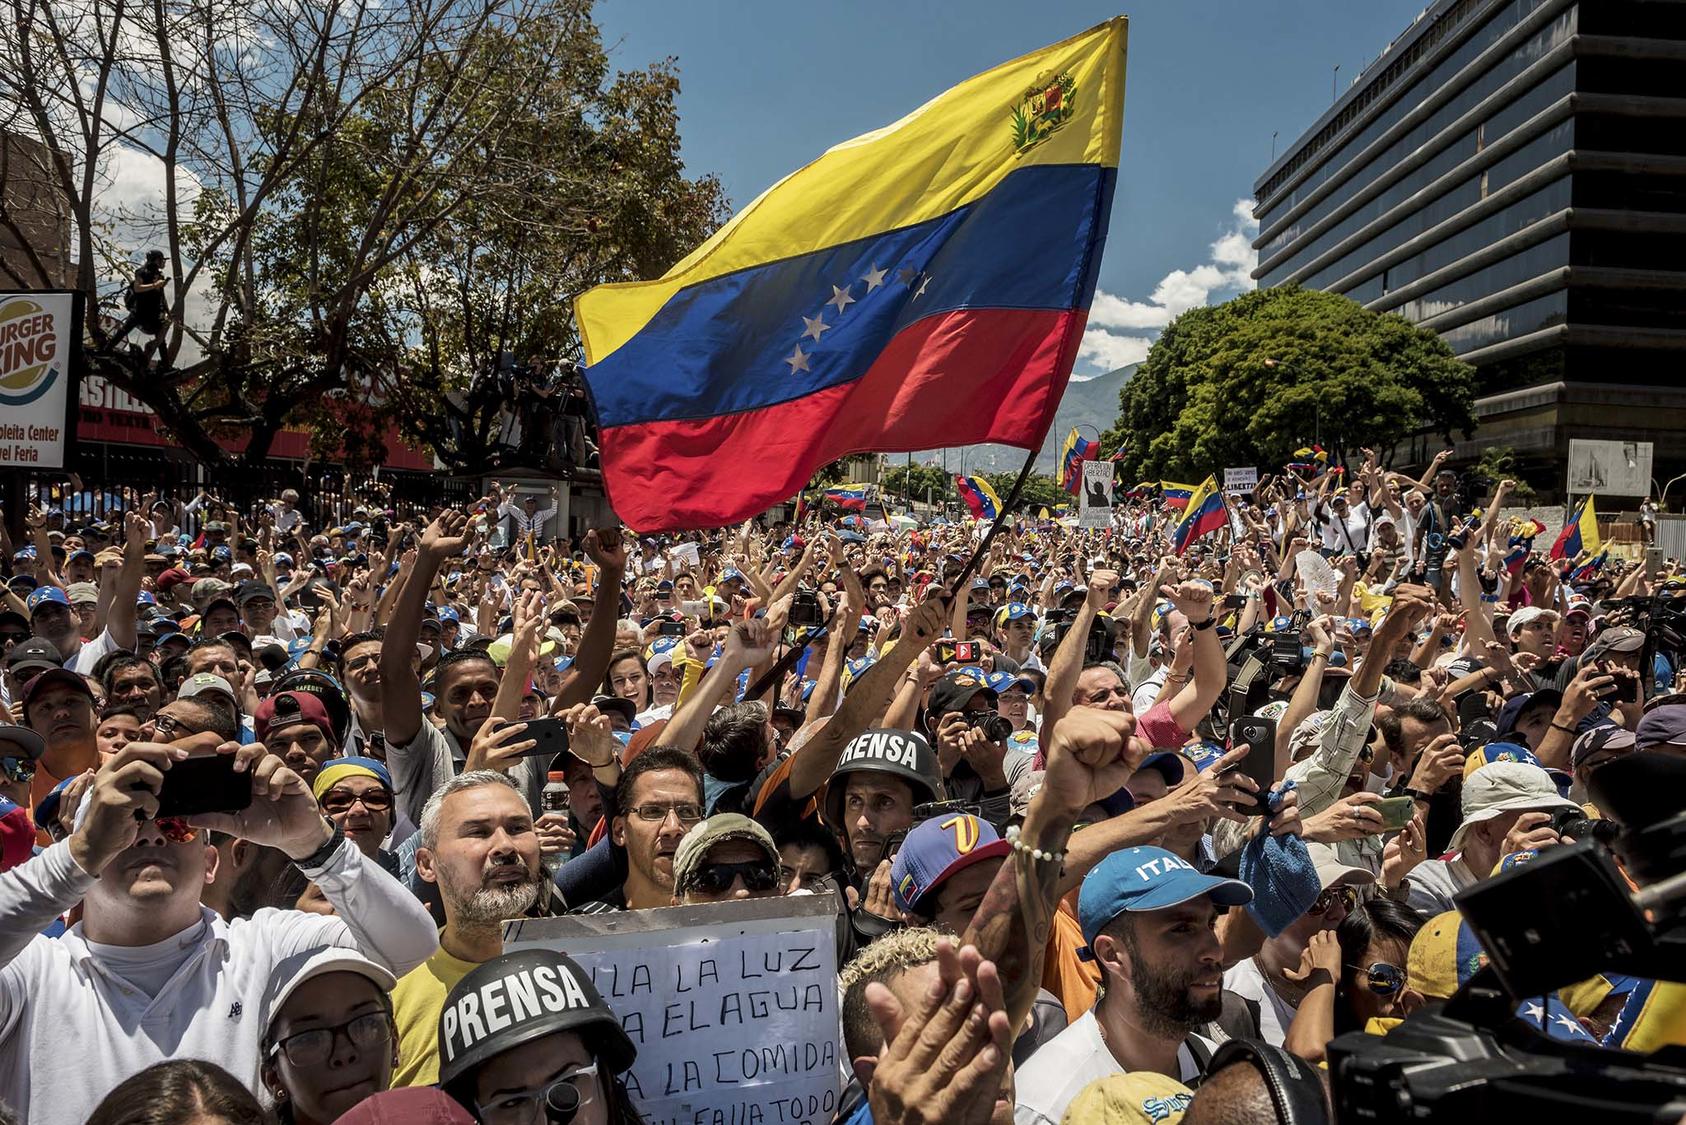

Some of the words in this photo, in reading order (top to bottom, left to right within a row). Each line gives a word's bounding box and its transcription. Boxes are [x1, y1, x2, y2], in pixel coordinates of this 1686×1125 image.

[28, 424, 59, 442] Center
[15, 445, 38, 462] Feria
[1136, 856, 1196, 882] ITAL
[676, 960, 719, 992] LA
[741, 948, 821, 979] LUZ
[443, 965, 590, 1061] PRENSA
[664, 1061, 702, 1096] LA
[713, 1041, 834, 1084] COMIDA
[770, 1090, 834, 1122] TODO
